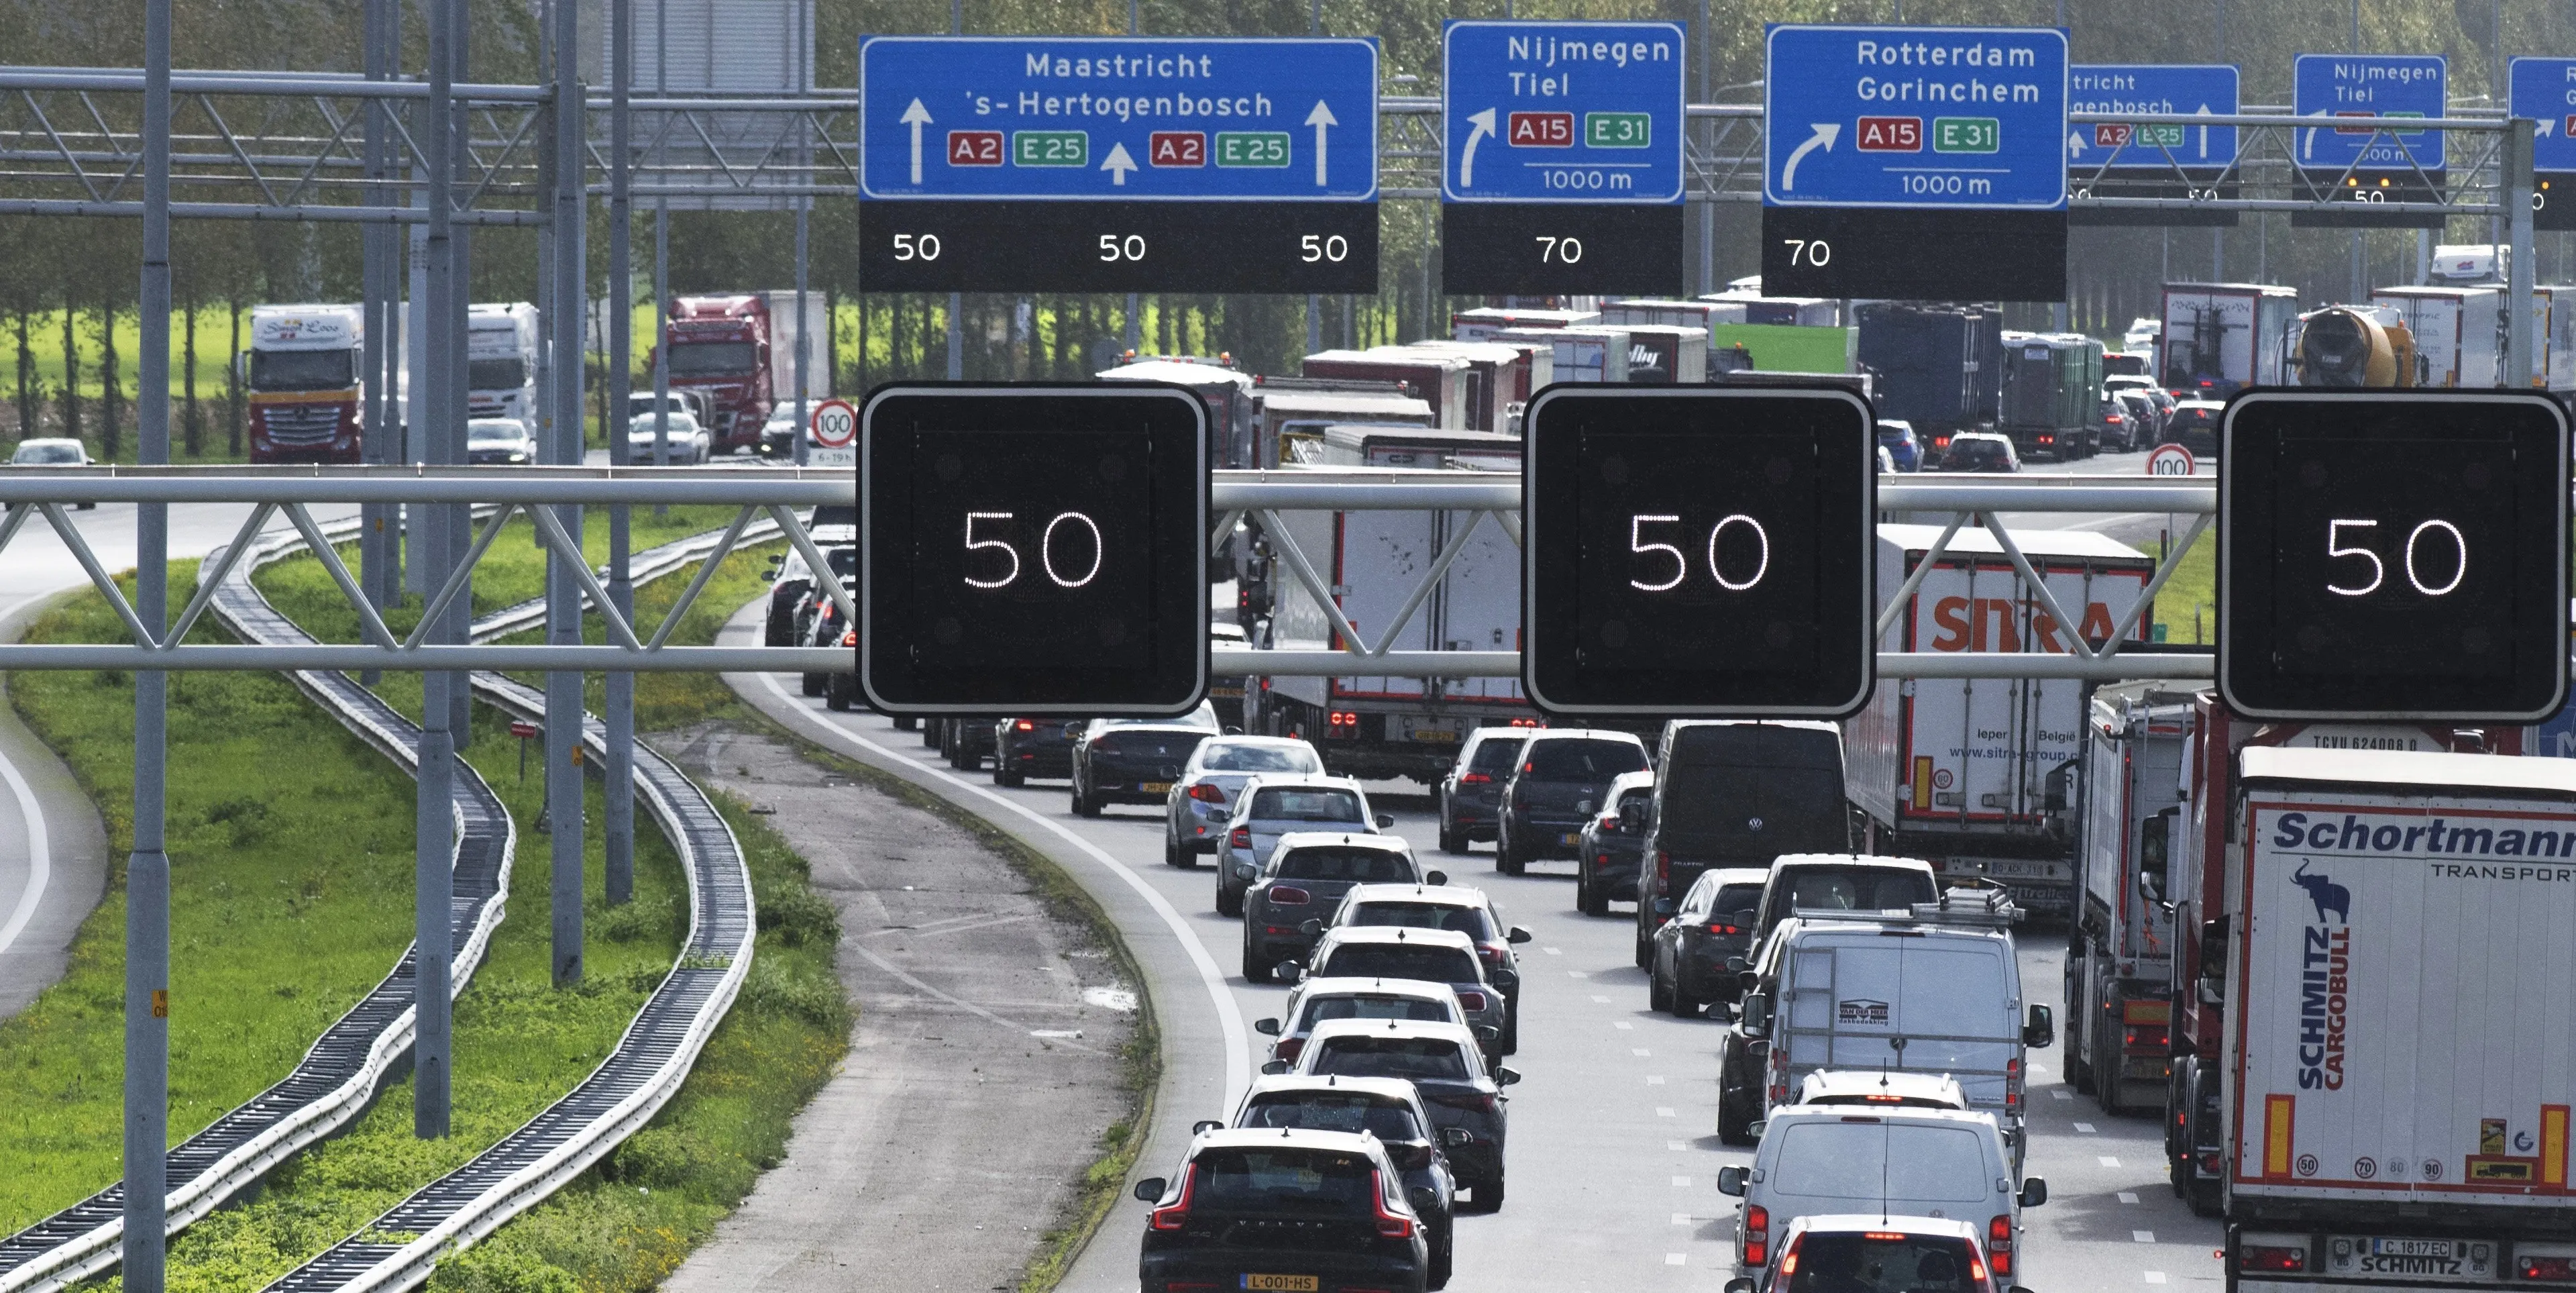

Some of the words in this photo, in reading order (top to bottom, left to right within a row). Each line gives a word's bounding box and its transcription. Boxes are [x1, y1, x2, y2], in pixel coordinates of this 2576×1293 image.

[1509, 36, 1669, 67] Nijmegen
[1858, 41, 2035, 66] Rotterdam
[1026, 53, 1212, 78] Maastricht
[2335, 64, 2436, 85] Nijmegen
[1509, 72, 1568, 96] Tiel
[1858, 76, 2039, 103] Gorinchem
[2335, 87, 2373, 102] Tiel
[966, 91, 1271, 123] 's-Hertogenbosch
[1517, 119, 1567, 140] A15
[1865, 123, 1915, 144] A15
[1544, 170, 1603, 189] 1000
[1610, 173, 1631, 189] m
[1902, 175, 1962, 195] 1000
[1969, 178, 1991, 195] m
[894, 234, 941, 261] 50
[1099, 235, 1146, 262] 50
[1301, 236, 1348, 262] 50
[1536, 237, 1582, 264] 70
[1784, 239, 1831, 266] 70
[820, 414, 851, 433] 100
[2155, 459, 2193, 475] 100
[965, 512, 1102, 588] 50
[1631, 514, 1768, 591] 50
[2327, 519, 2466, 595] 50
[1931, 596, 2115, 654] SITRA
[2038, 730, 2076, 744] België
[2314, 735, 2347, 749] TCVU
[2353, 737, 2404, 751] 624008
[2298, 926, 2330, 1090] SCHMITZ
[2324, 927, 2350, 1090] CARGOBULL
[1839, 1018, 1888, 1026] dakbedekking
[2301, 1159, 2314, 1170] 50
[2358, 1161, 2371, 1173] 70
[2390, 1161, 2404, 1173] 80
[2425, 1164, 2439, 1175] 90
[2385, 1241, 2394, 1253] C
[2401, 1241, 2428, 1254] 1817
[2431, 1241, 2448, 1255] EC
[2361, 1257, 2462, 1276] SCHMITZ
[1252, 1276, 1312, 1289] L-001-HS
